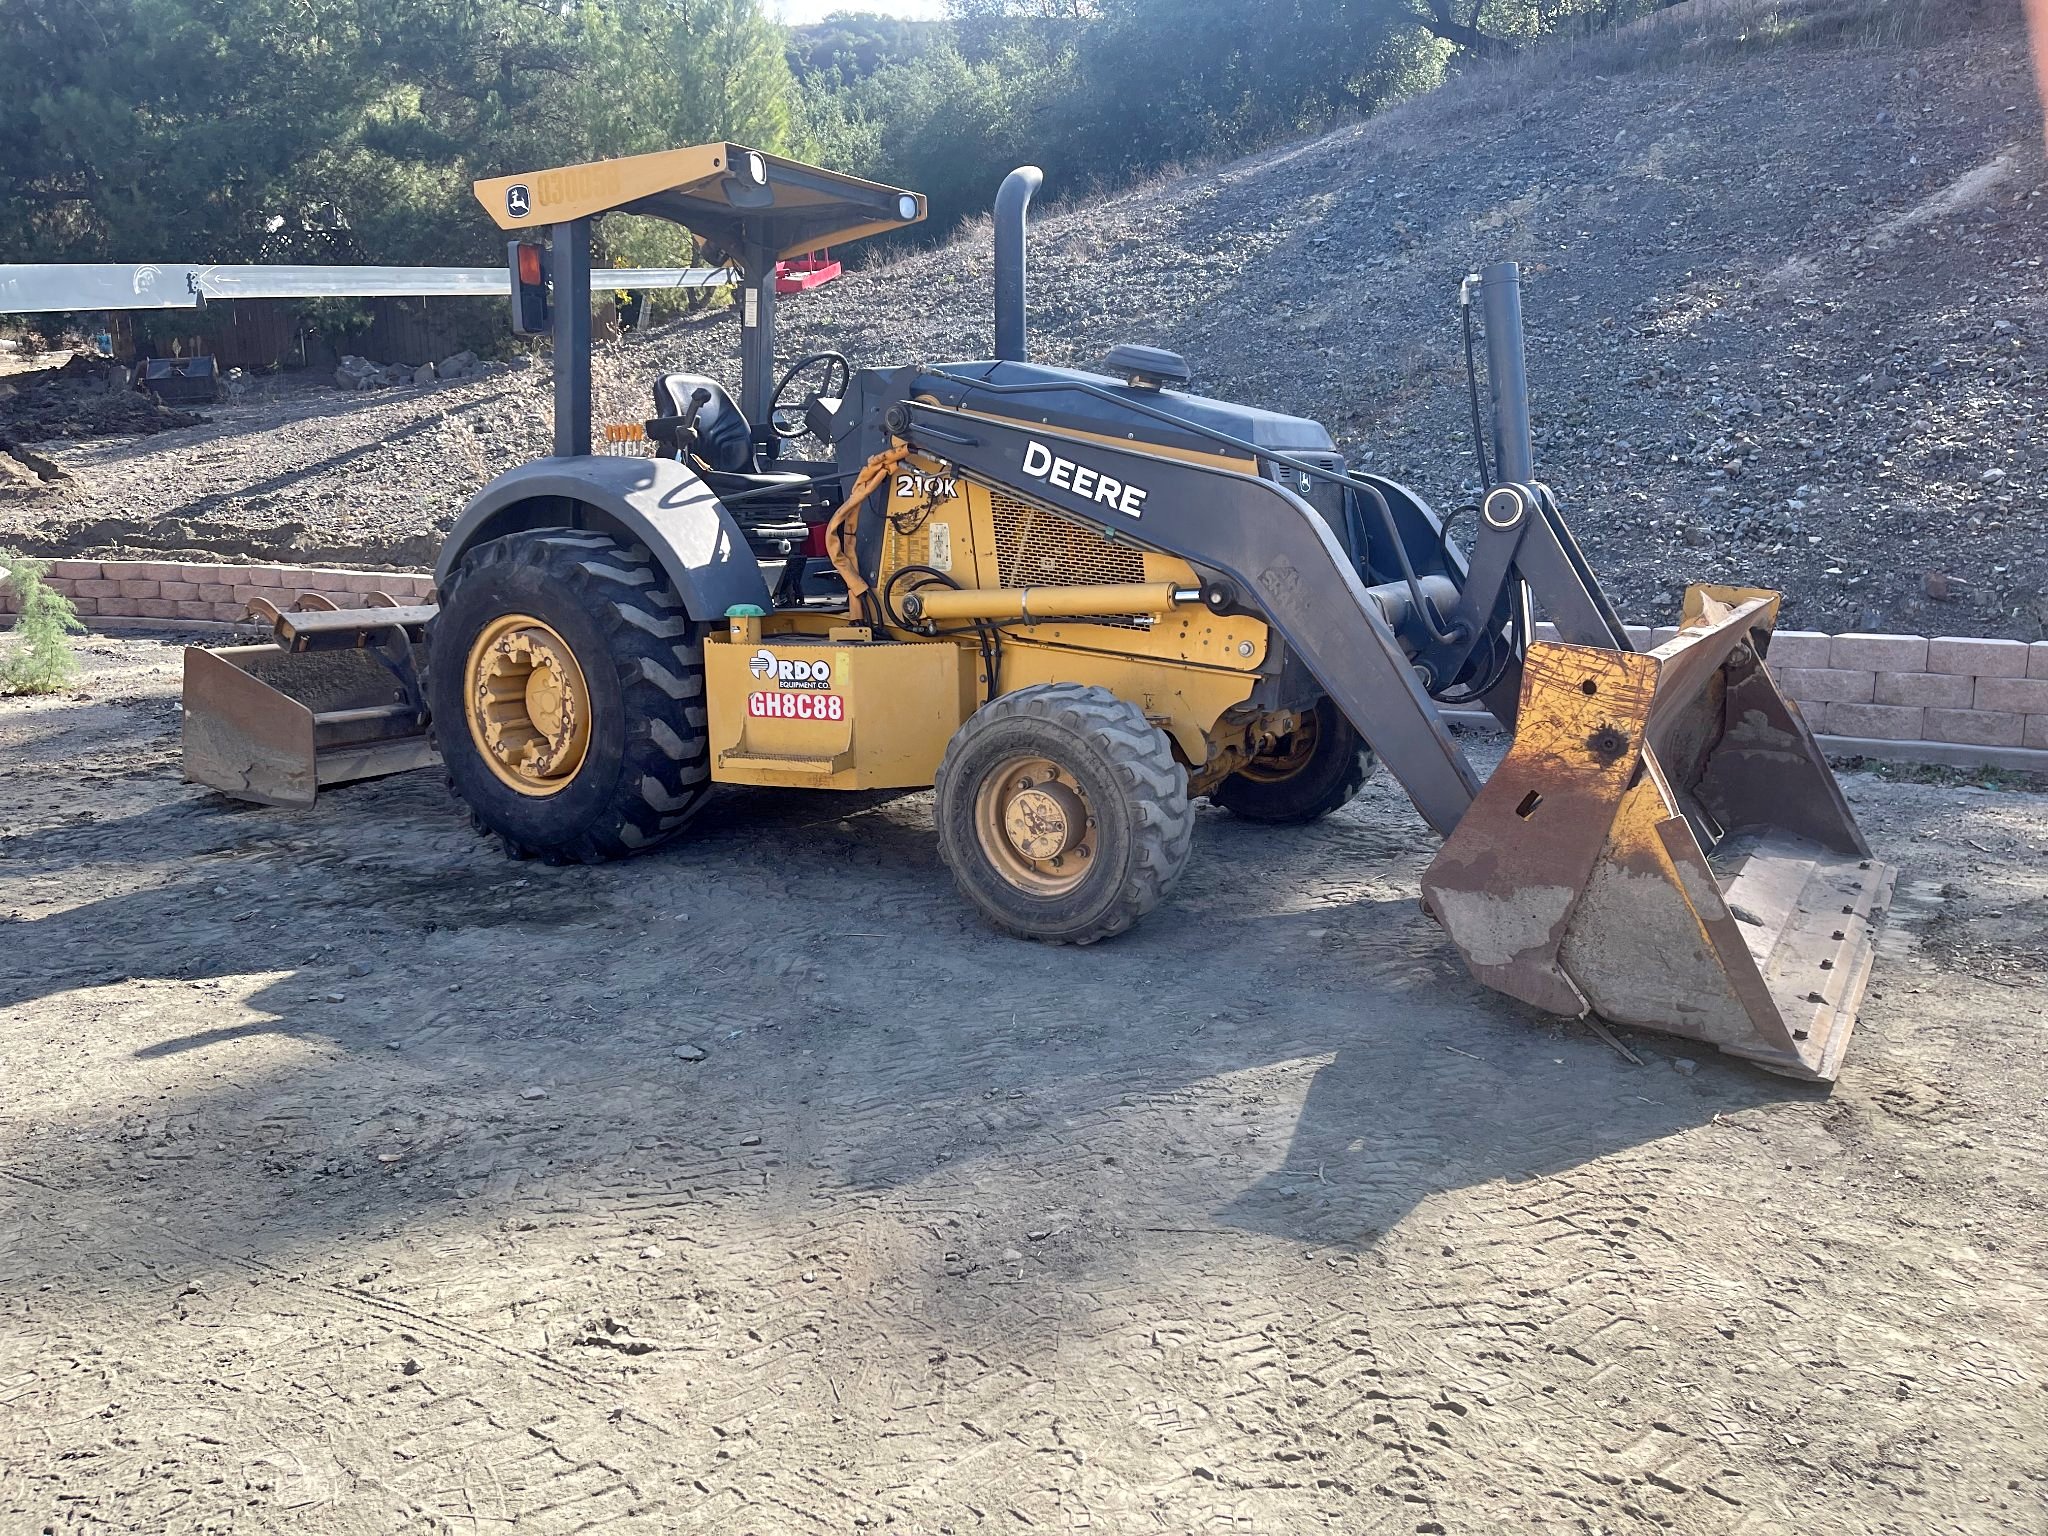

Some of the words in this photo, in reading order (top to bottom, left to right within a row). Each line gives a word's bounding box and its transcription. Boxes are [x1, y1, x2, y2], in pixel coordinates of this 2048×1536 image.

[897, 475, 958, 498] 210K
[1022, 440, 1147, 518] DEERE
[779, 681, 817, 689] EQUIPMENT
[750, 692, 842, 720] GH8C88
